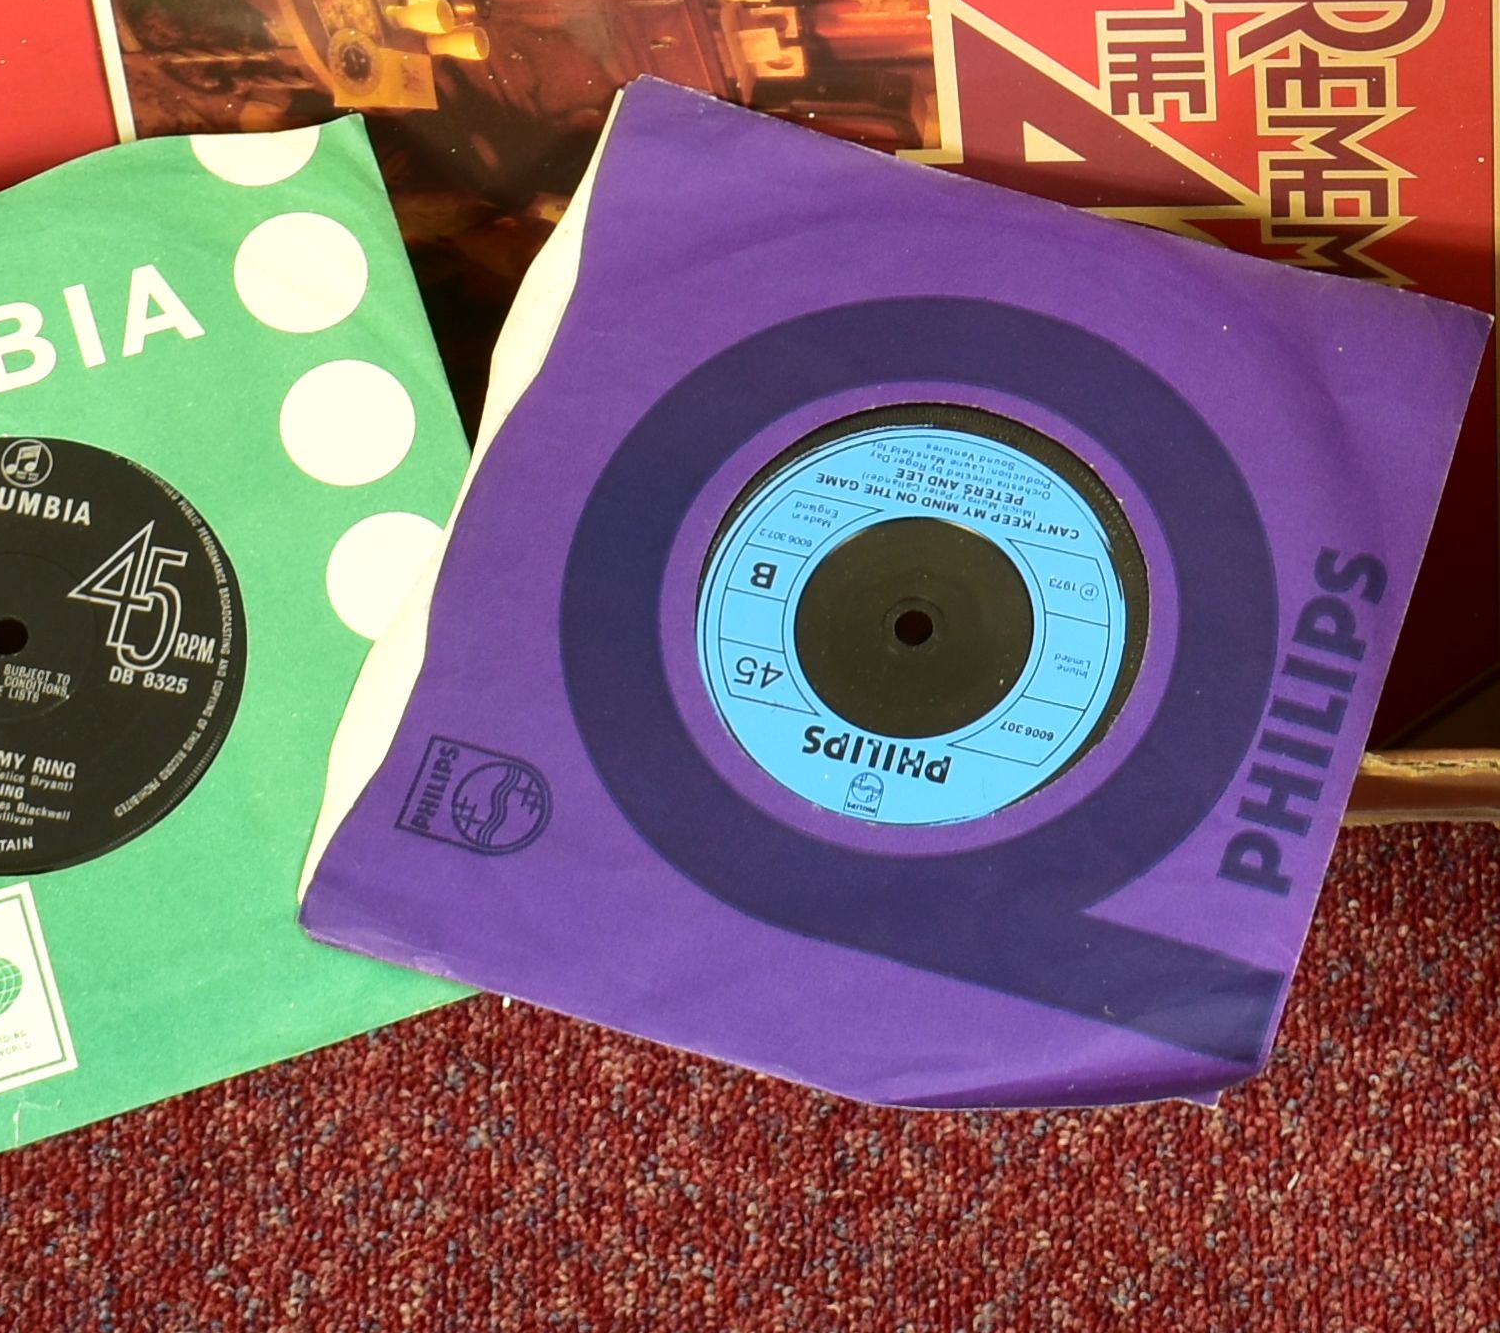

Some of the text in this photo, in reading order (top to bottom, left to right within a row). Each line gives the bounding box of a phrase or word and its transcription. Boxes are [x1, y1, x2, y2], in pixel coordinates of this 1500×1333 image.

[1096, 10, 1217, 123] THE
[896, 467, 1025, 506] PETERS AND LEE
[793, 500, 839, 520] England
[802, 512, 832, 529] Made
[815, 472, 1080, 540] CAN'T KEEP MY MIND ON THE GAME
[749, 561, 778, 589] B
[66, 519, 189, 673] 45
[108, 665, 189, 695] DB 8325
[733, 655, 784, 689] 45
[999, 720, 1054, 742] 6006 307
[1215, 543, 1388, 899] PHILIPS
[32, 756, 77, 779] RING
[801, 724, 951, 784] PHILIPS
[412, 743, 461, 835] PHILIPS
[16, 802, 71, 821] Blackwell
